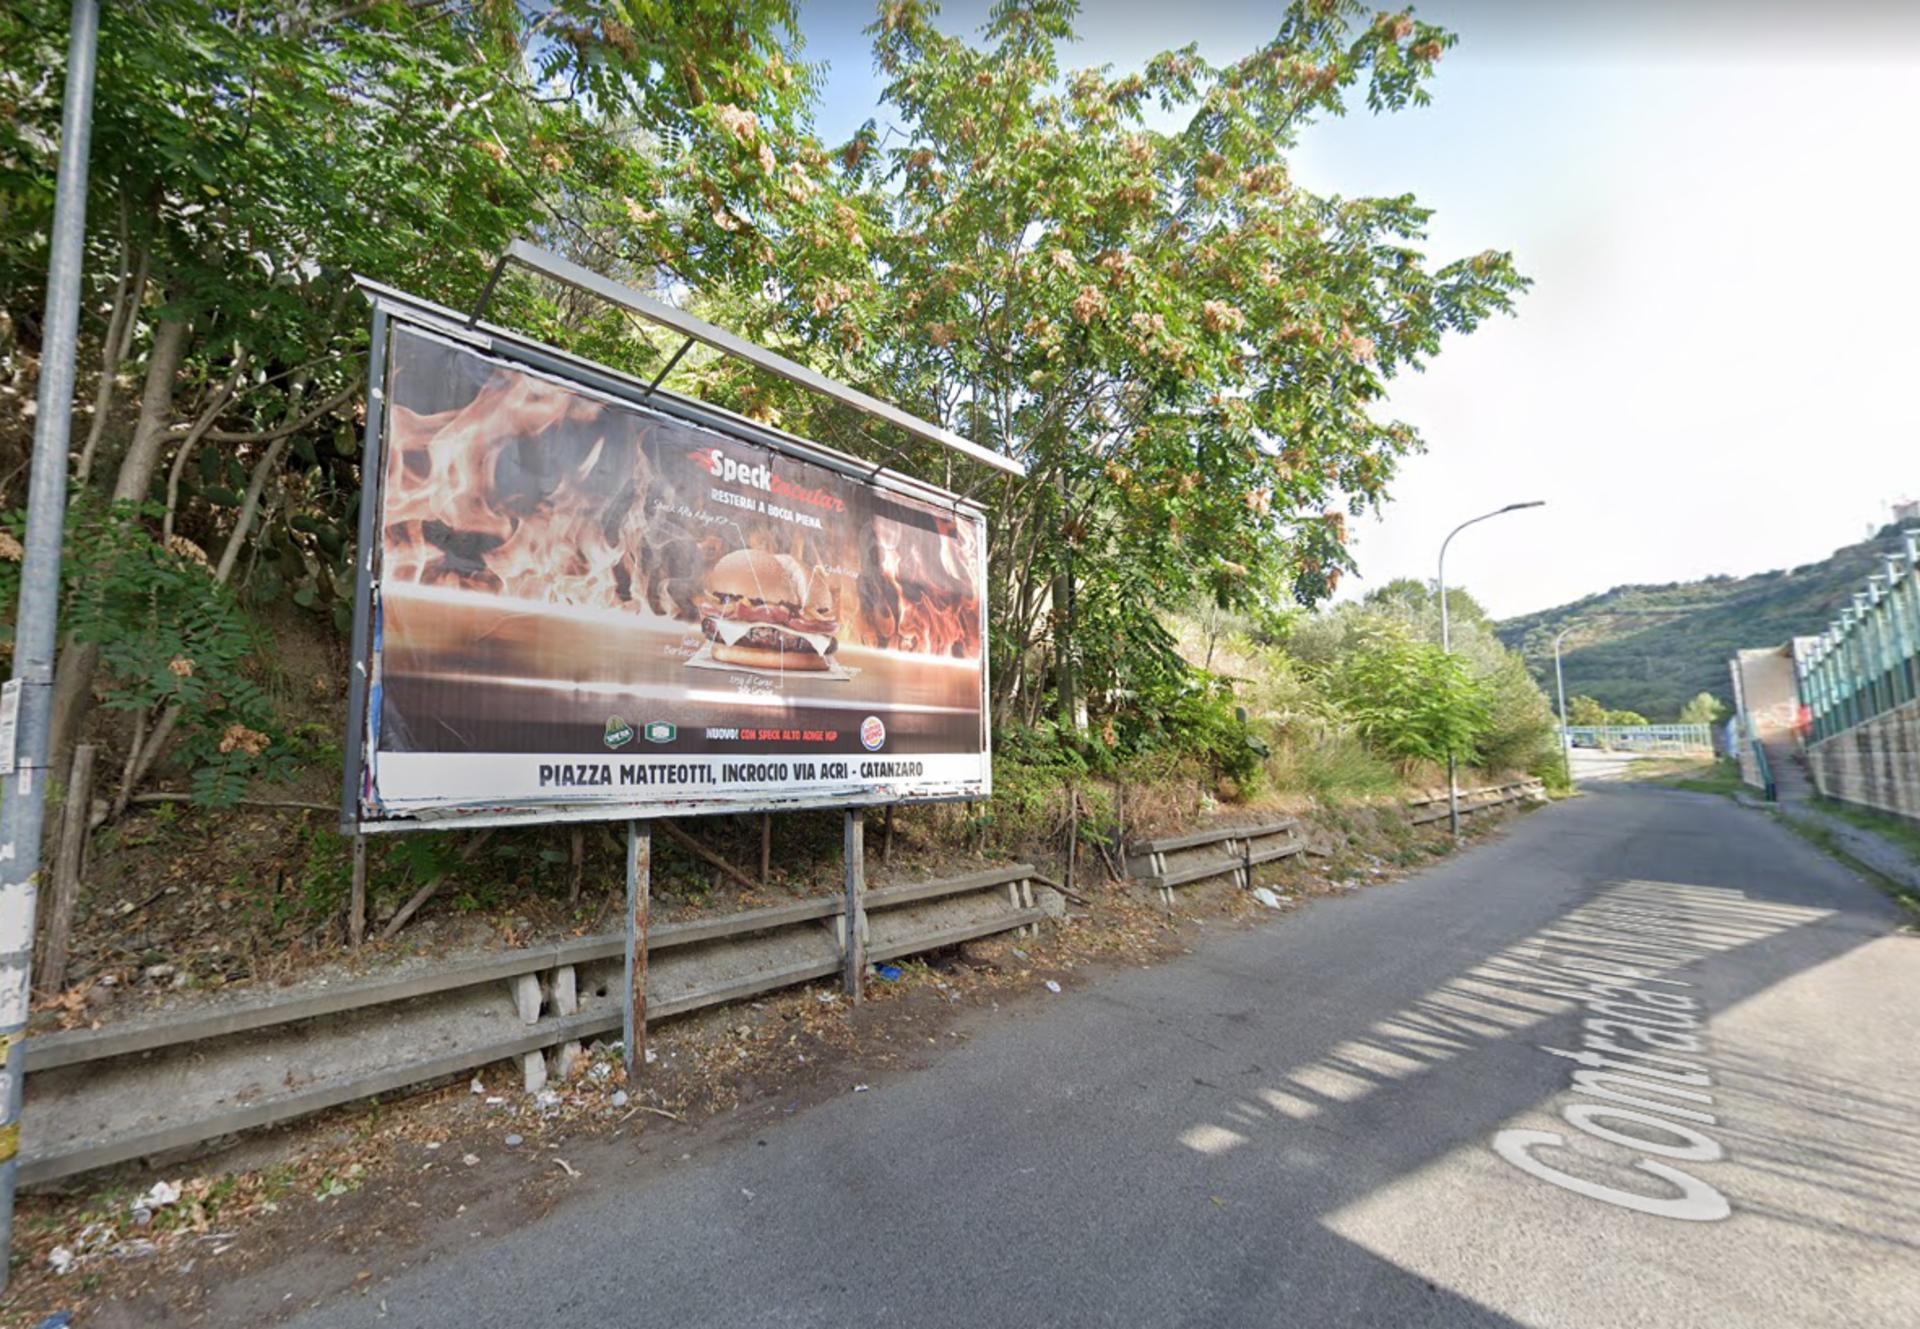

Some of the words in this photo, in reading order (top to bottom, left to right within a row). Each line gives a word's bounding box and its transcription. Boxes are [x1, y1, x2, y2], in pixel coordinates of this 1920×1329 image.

[711, 488, 756, 511] RESTERAI
[758, 501, 766, 513] A
[767, 504, 794, 523] BOCCA
[706, 727, 739, 740] NUOVO!
[740, 728, 756, 740] CON
[758, 729, 780, 740] SPECK
[782, 730, 801, 740] ALTO
[539, 764, 612, 787] PIAZZA
[620, 764, 717, 785] MATTEOTTI,
[722, 763, 788, 783] INCROCIO
[793, 763, 816, 780] VIA
[820, 762, 848, 780] ACRI
[860, 761, 924, 779] CATANZARO
